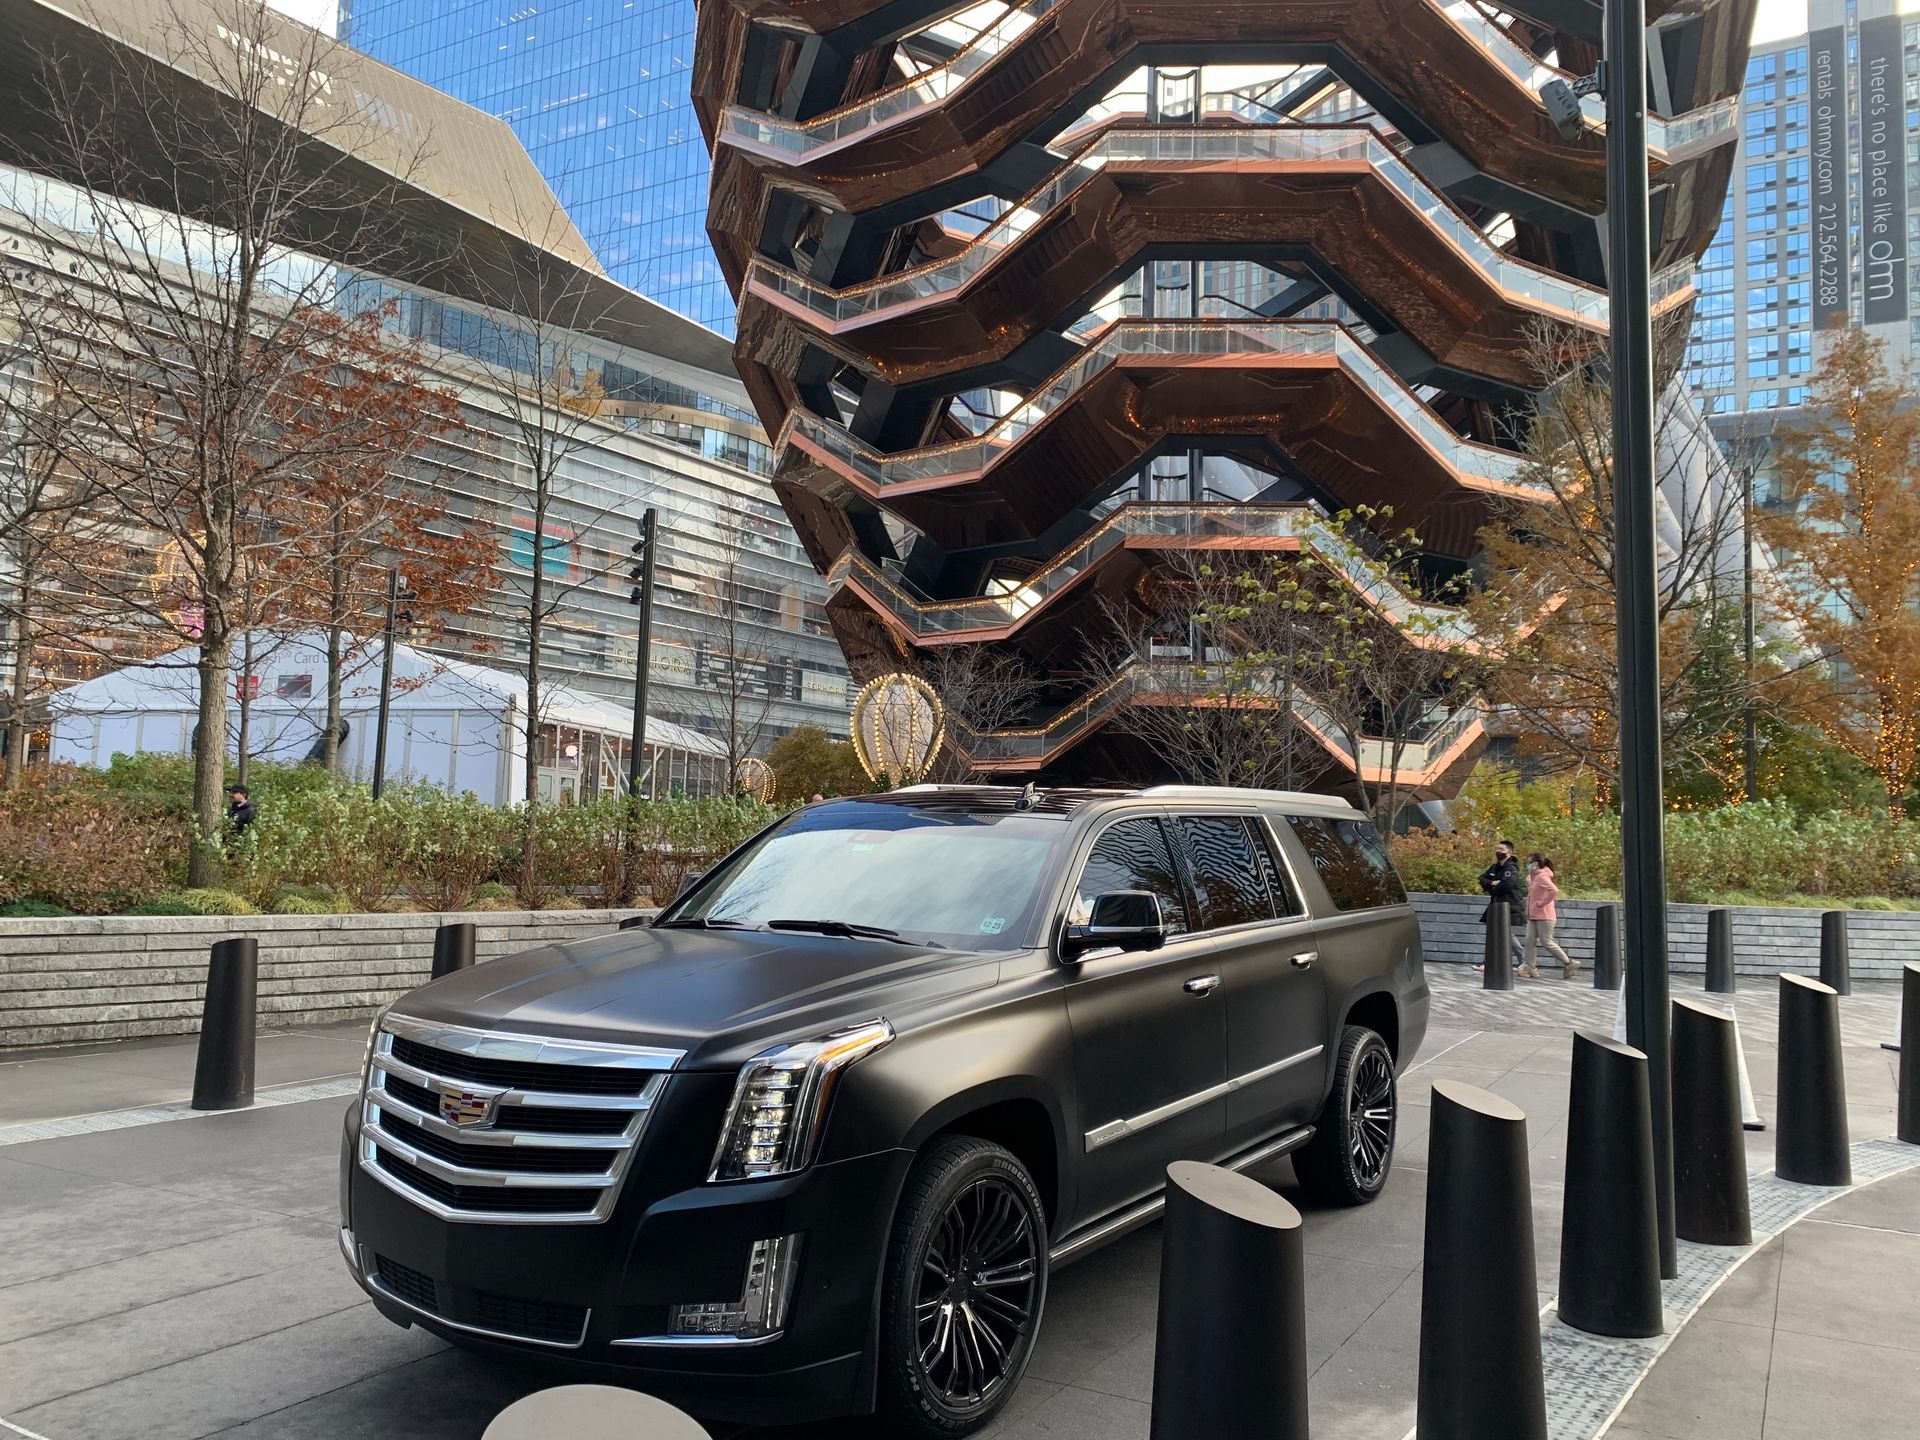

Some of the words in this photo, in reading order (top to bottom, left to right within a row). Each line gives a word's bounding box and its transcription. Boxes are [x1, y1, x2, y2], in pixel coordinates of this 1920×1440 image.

[1817, 49, 1837, 100] rentals
[1870, 57, 1890, 115] there's
[1813, 105, 1837, 195] ohmny.com
[1872, 120, 1886, 144] no
[1867, 149, 1892, 198] place
[1873, 202, 1893, 233] like
[1819, 202, 1838, 306] 212.564.2288
[1869, 240, 1905, 300] ohm
[294, 652, 320, 664] Card
[615, 648, 691, 674] SEHORA
